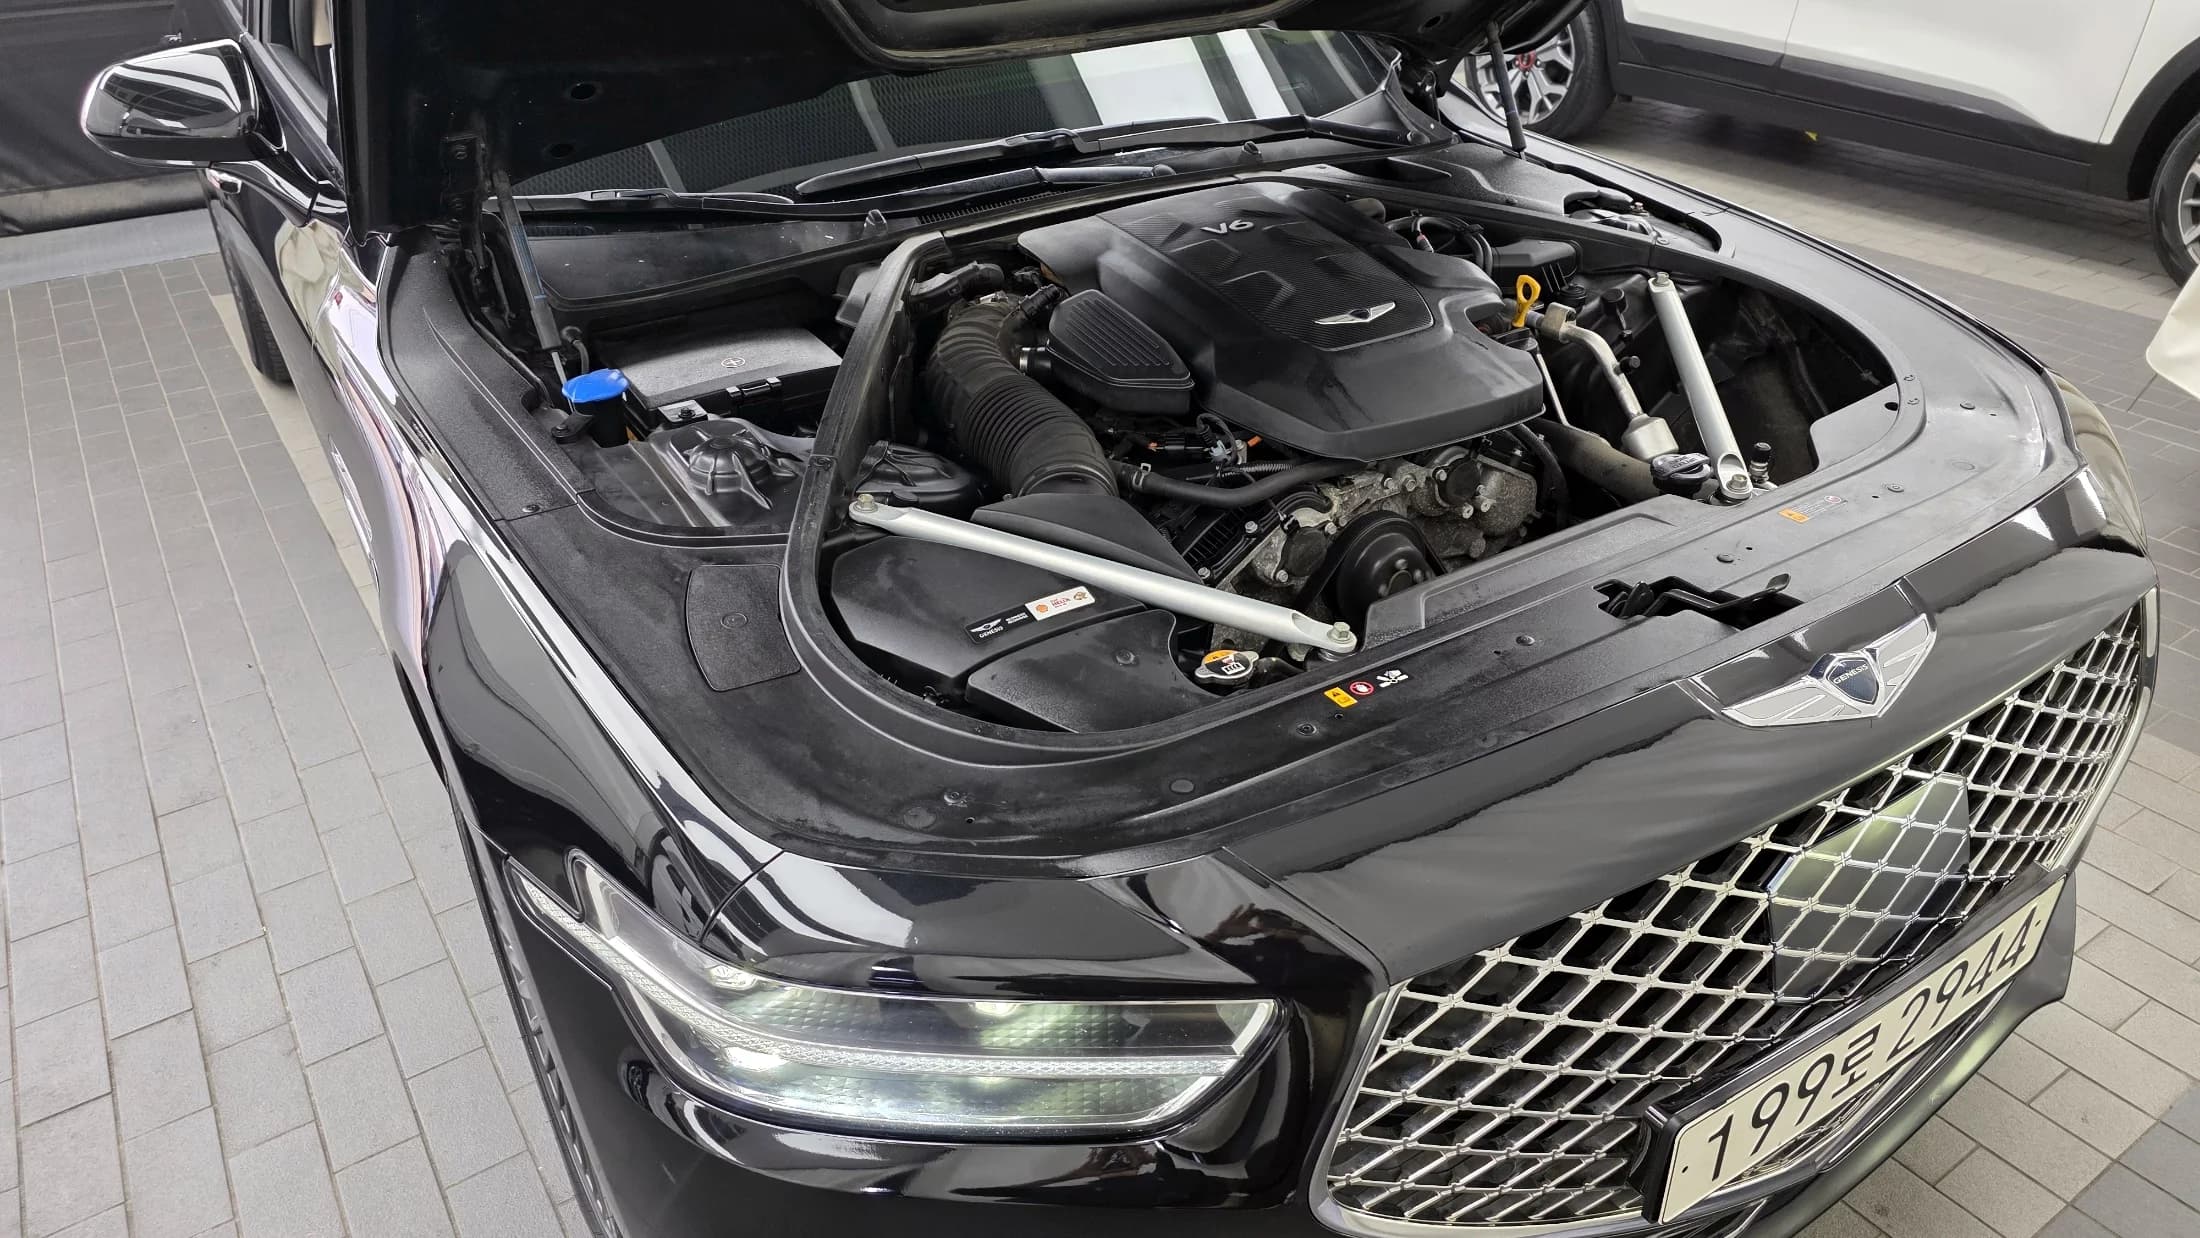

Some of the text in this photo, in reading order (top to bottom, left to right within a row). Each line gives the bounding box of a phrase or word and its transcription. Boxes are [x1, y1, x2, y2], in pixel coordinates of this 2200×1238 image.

[1200, 219, 1255, 234] V6
[979, 625, 1004, 638] GENESIS
[1832, 662, 1870, 684] GENESIS
[1707, 905, 2038, 1182] 199로 2944
